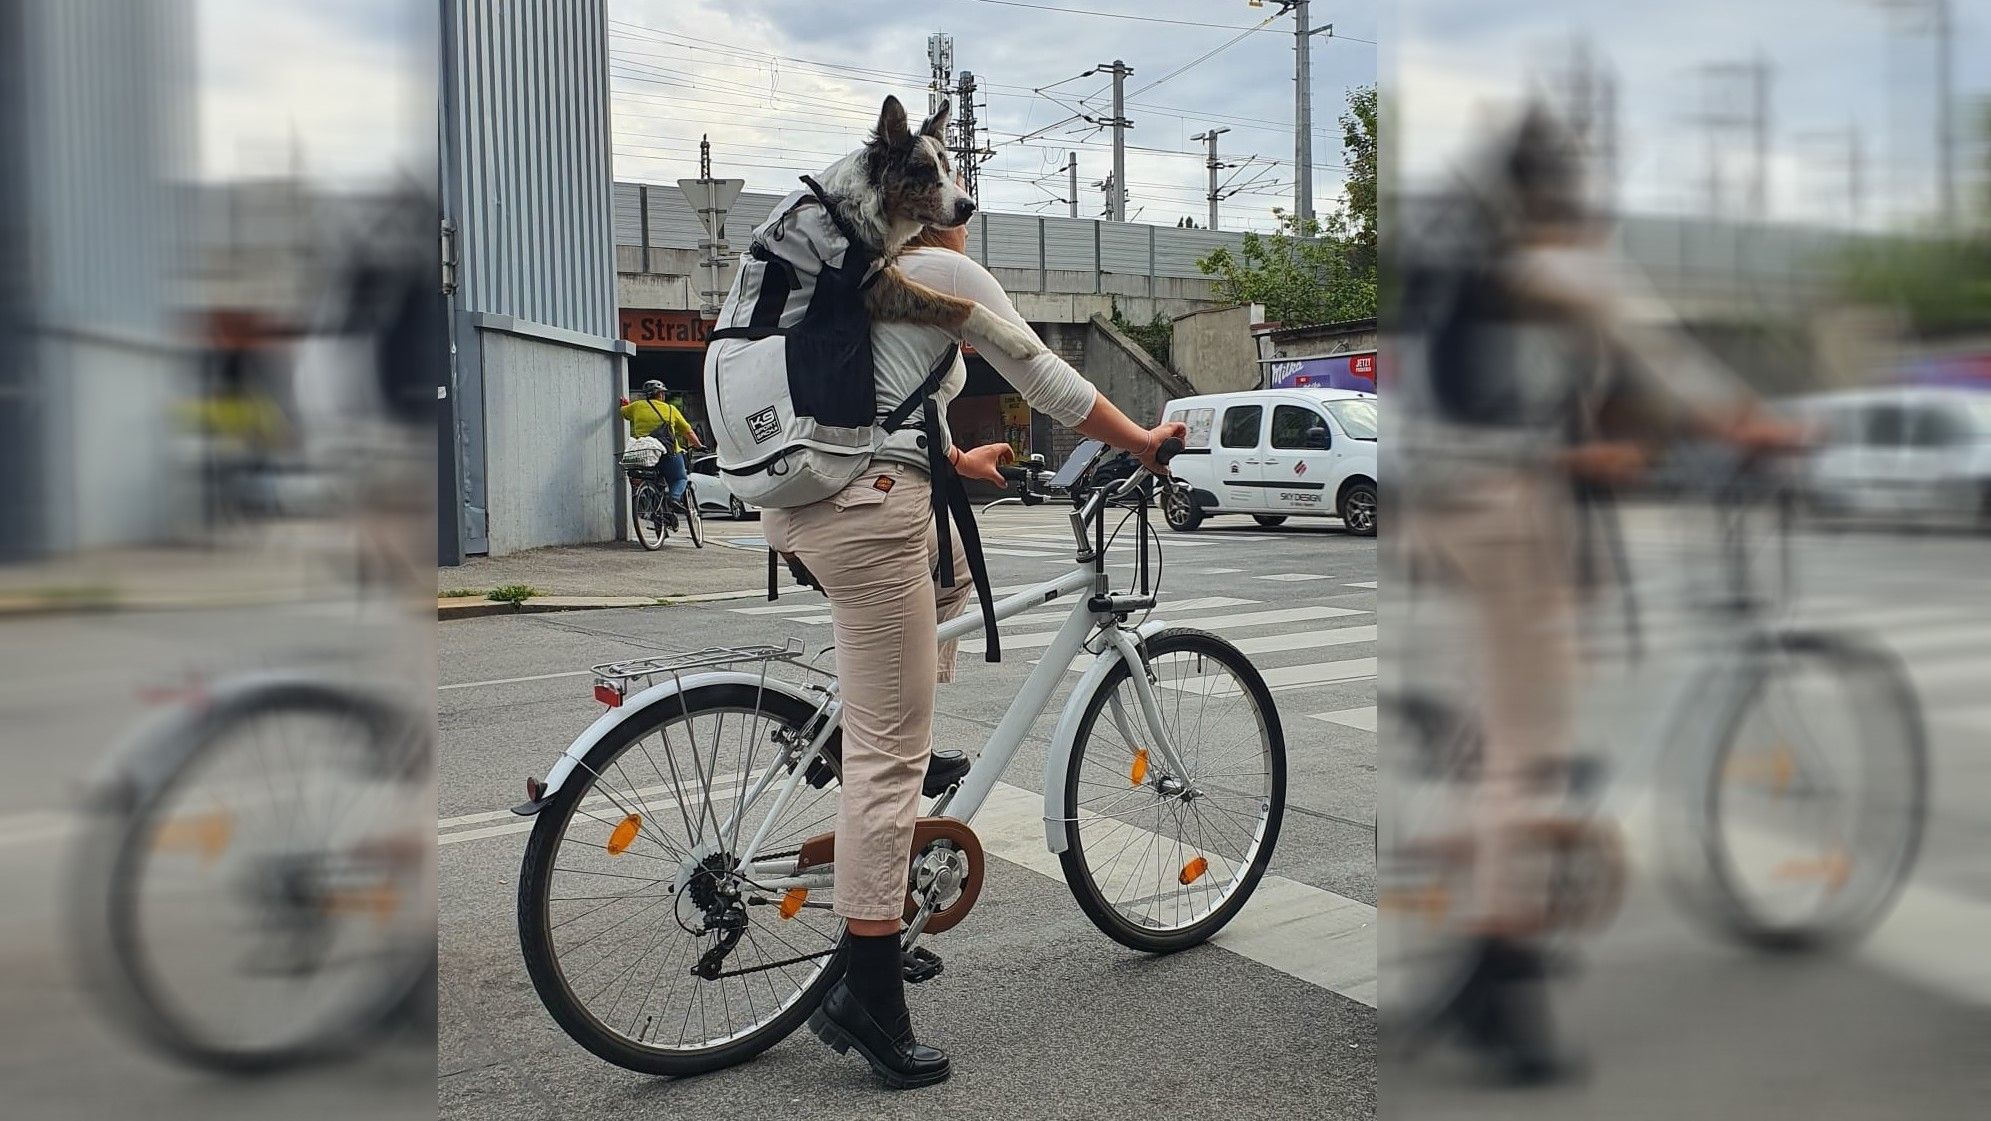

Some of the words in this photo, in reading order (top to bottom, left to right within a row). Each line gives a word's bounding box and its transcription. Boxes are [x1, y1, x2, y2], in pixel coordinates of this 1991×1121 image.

[1271, 361, 1304, 386] Milka
[750, 411, 775, 430] K9
[1280, 492, 1293, 501] SKY
[1295, 493, 1323, 502] DESIGN
